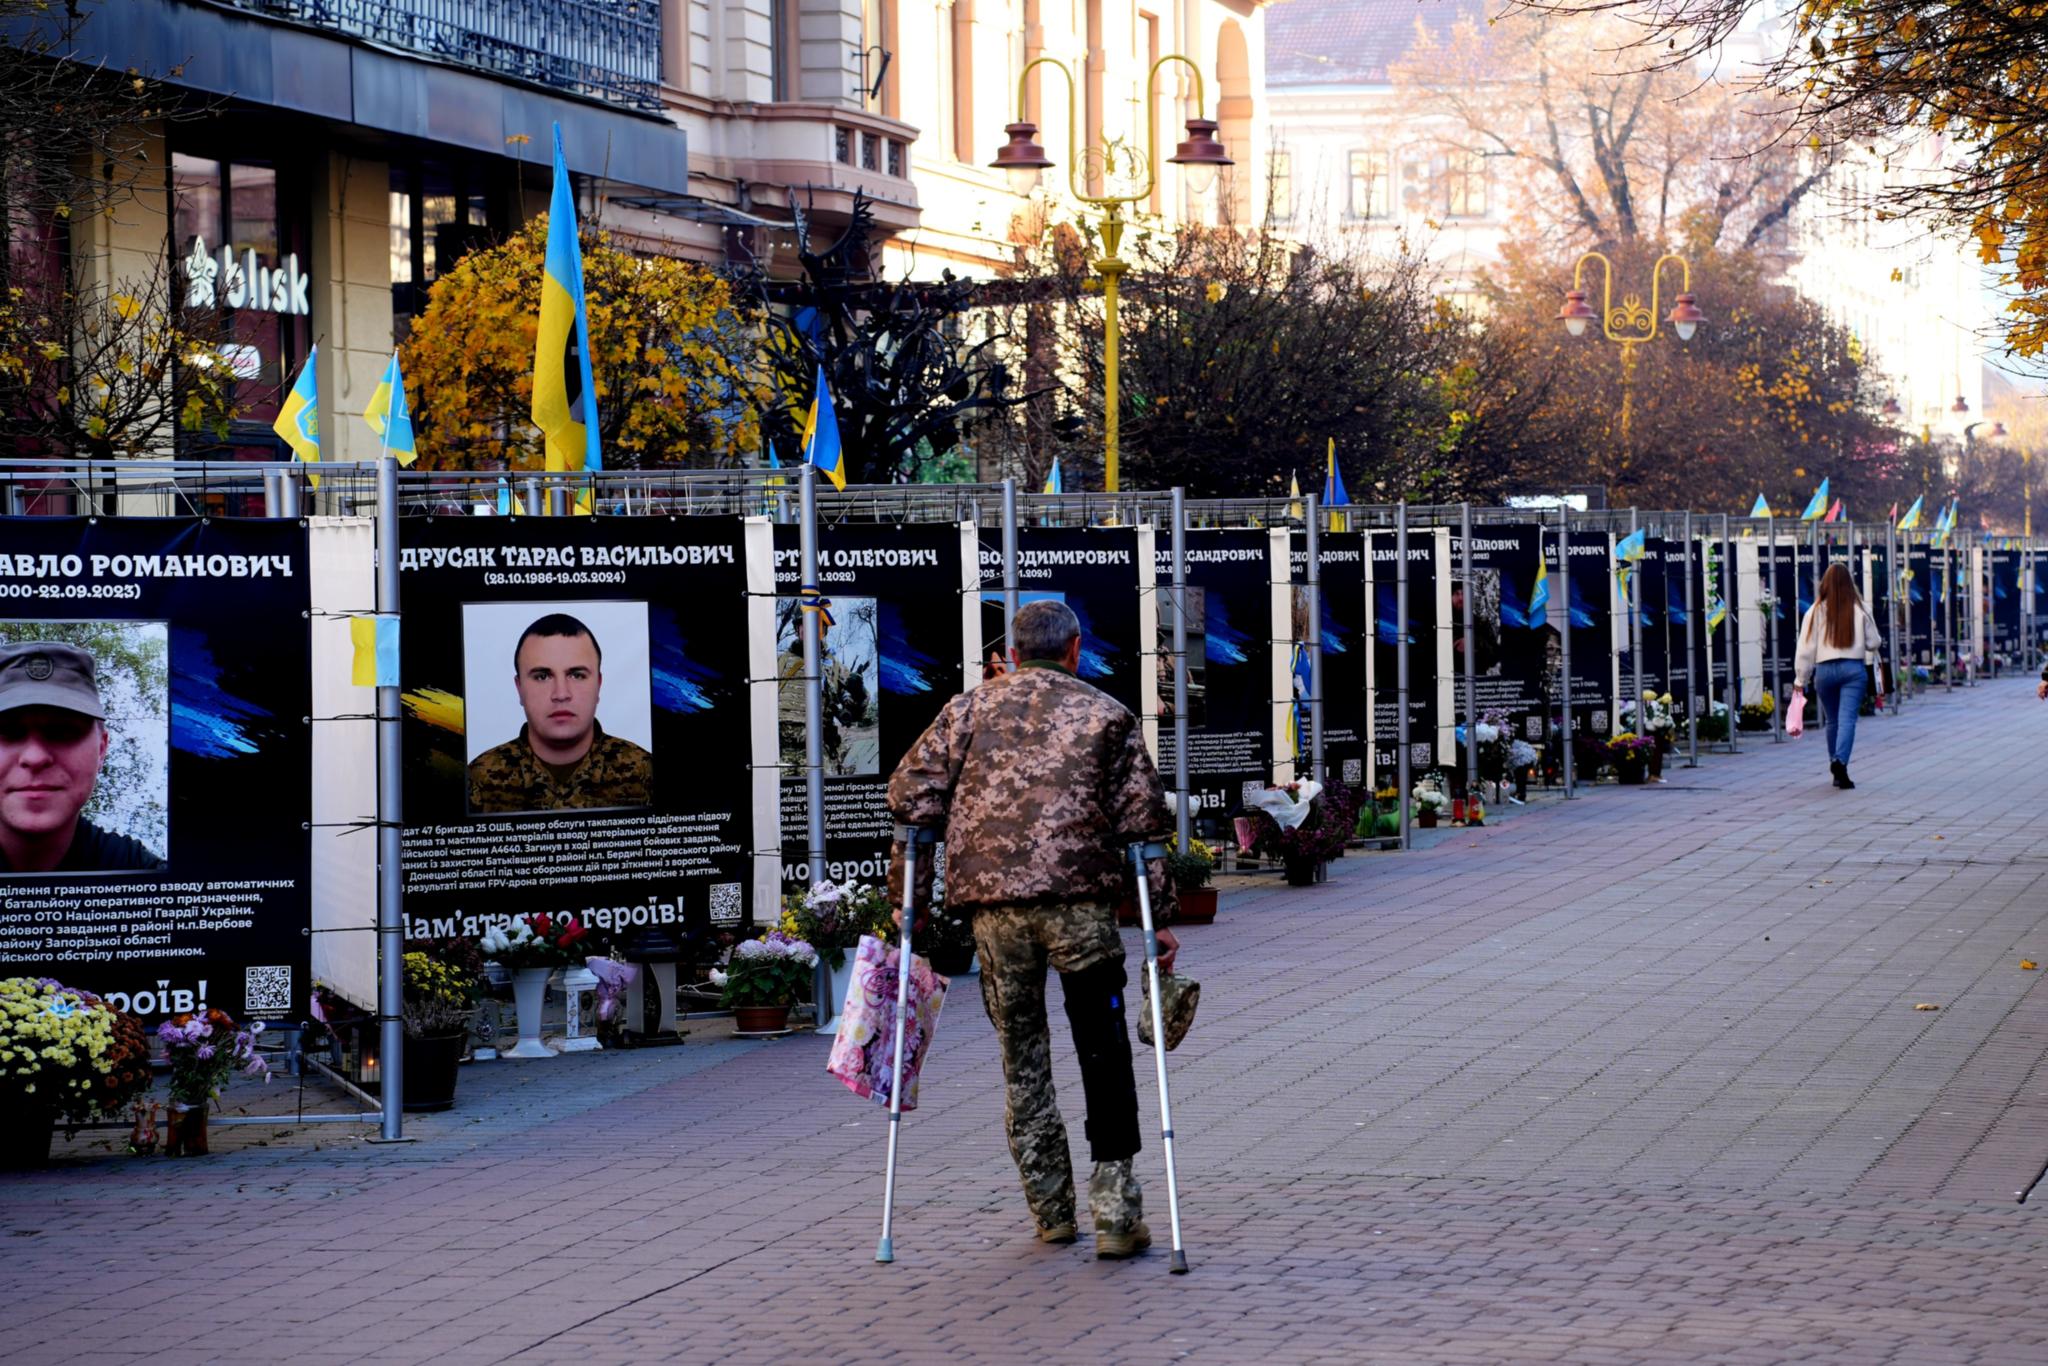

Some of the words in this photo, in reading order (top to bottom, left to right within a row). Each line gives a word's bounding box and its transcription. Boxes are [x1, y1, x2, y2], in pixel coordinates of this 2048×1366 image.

[225, 244, 309, 316] blisk
[90, 554, 293, 578] РОМАНОВИЧ
[400, 547, 496, 570] ДРУСЯК
[501, 545, 575, 567] ТАРАС
[580, 544, 735, 567] ВАСИЛЬОВИЧ
[774, 549, 830, 567] РТМ
[834, 549, 938, 568] ОЛЕГОВИЧ
[979, 550, 1130, 567] ВООДИМИРОВИЧ
[484, 571, 626, 585] (28.10.1986-19.03.2024)
[401, 828, 420, 838] дат
[421, 826, 433, 835] 47
[435, 824, 475, 836] бригада
[476, 823, 487, 832] 25
[489, 822, 514, 833] ОШБ,
[516, 822, 546, 833] номер
[548, 819, 585, 831] обслуги
[587, 817, 645, 828] такелажного
[647, 814, 696, 826] відділення
[698, 812, 732, 823] підвозу
[830, 812, 872, 821] доблесть»,
[873, 811, 895, 820] Нагр
[435, 838, 446, 846] та
[447, 835, 504, 845] мастильних
[506, 832, 555, 844] матеріалів
[556, 829, 588, 840] взводу
[590, 827, 655, 839] матеріального
[657, 825, 720, 835] забезпечення
[834, 830, 879, 839] «Захиснику
[450, 846, 488, 856] частини
[490, 844, 523, 854] А4640.
[525, 842, 562, 853] Загинув
[572, 840, 590, 851] ході
[592, 839, 641, 849] виконання
[643, 837, 681, 847] бойових
[683, 834, 721, 845] завдань,
[430, 859, 438, 868] із
[440, 858, 484, 868] захистом
[485, 854, 546, 866] Батьківщини
[548, 855, 554, 863] в
[556, 851, 587, 863] районі
[588, 851, 605, 859] н.п.
[606, 847, 643, 859] Бердичі
[645, 845, 708, 857] Покровського
[709, 843, 742, 855] району
[409, 869, 459, 882] Донецької
[461, 867, 496, 878] області
[498, 865, 513, 877] під
[514, 866, 531, 875] час
[532, 863, 584, 876] оборонних
[585, 861, 600, 872] дій
[602, 861, 620, 873] при
[621, 859, 663, 869] зіткненні
[671, 857, 712, 869] ворогом.
[54, 883, 157, 897] гранатометного
[160, 881, 203, 894] взводу
[207, 878, 295, 891] автоматичних
[407, 880, 457, 894] результаті
[459, 880, 486, 890] атаки
[488, 877, 537, 889] FPV-дрона
[539, 876, 578, 888] отримав
[580, 873, 630, 884] поранення
[631, 869, 678, 881] несумісне
[686, 867, 722, 877] життям.
[5, 898, 81, 910] батальйону
[84, 896, 174, 908] оперативного
[177, 893, 263, 906] призначення,
[0, 913, 31, 923] ного
[34, 911, 63, 921] ОТО
[66, 907, 152, 922] Національної
[155, 906, 199, 919] Гвардії
[202, 905, 255, 918] України.
[581, 896, 685, 934] героїв!
[56, 923, 117, 935] завдання
[121, 924, 128, 932] в
[130, 920, 174, 934] районі
[177, 918, 253, 931] н.п.Вербове
[45, 935, 121, 949] Запорізької
[124, 933, 171, 946] області
[57, 949, 113, 962] обстрілу
[117, 946, 206, 960] противником.
[93, 979, 208, 1015] роїв!
